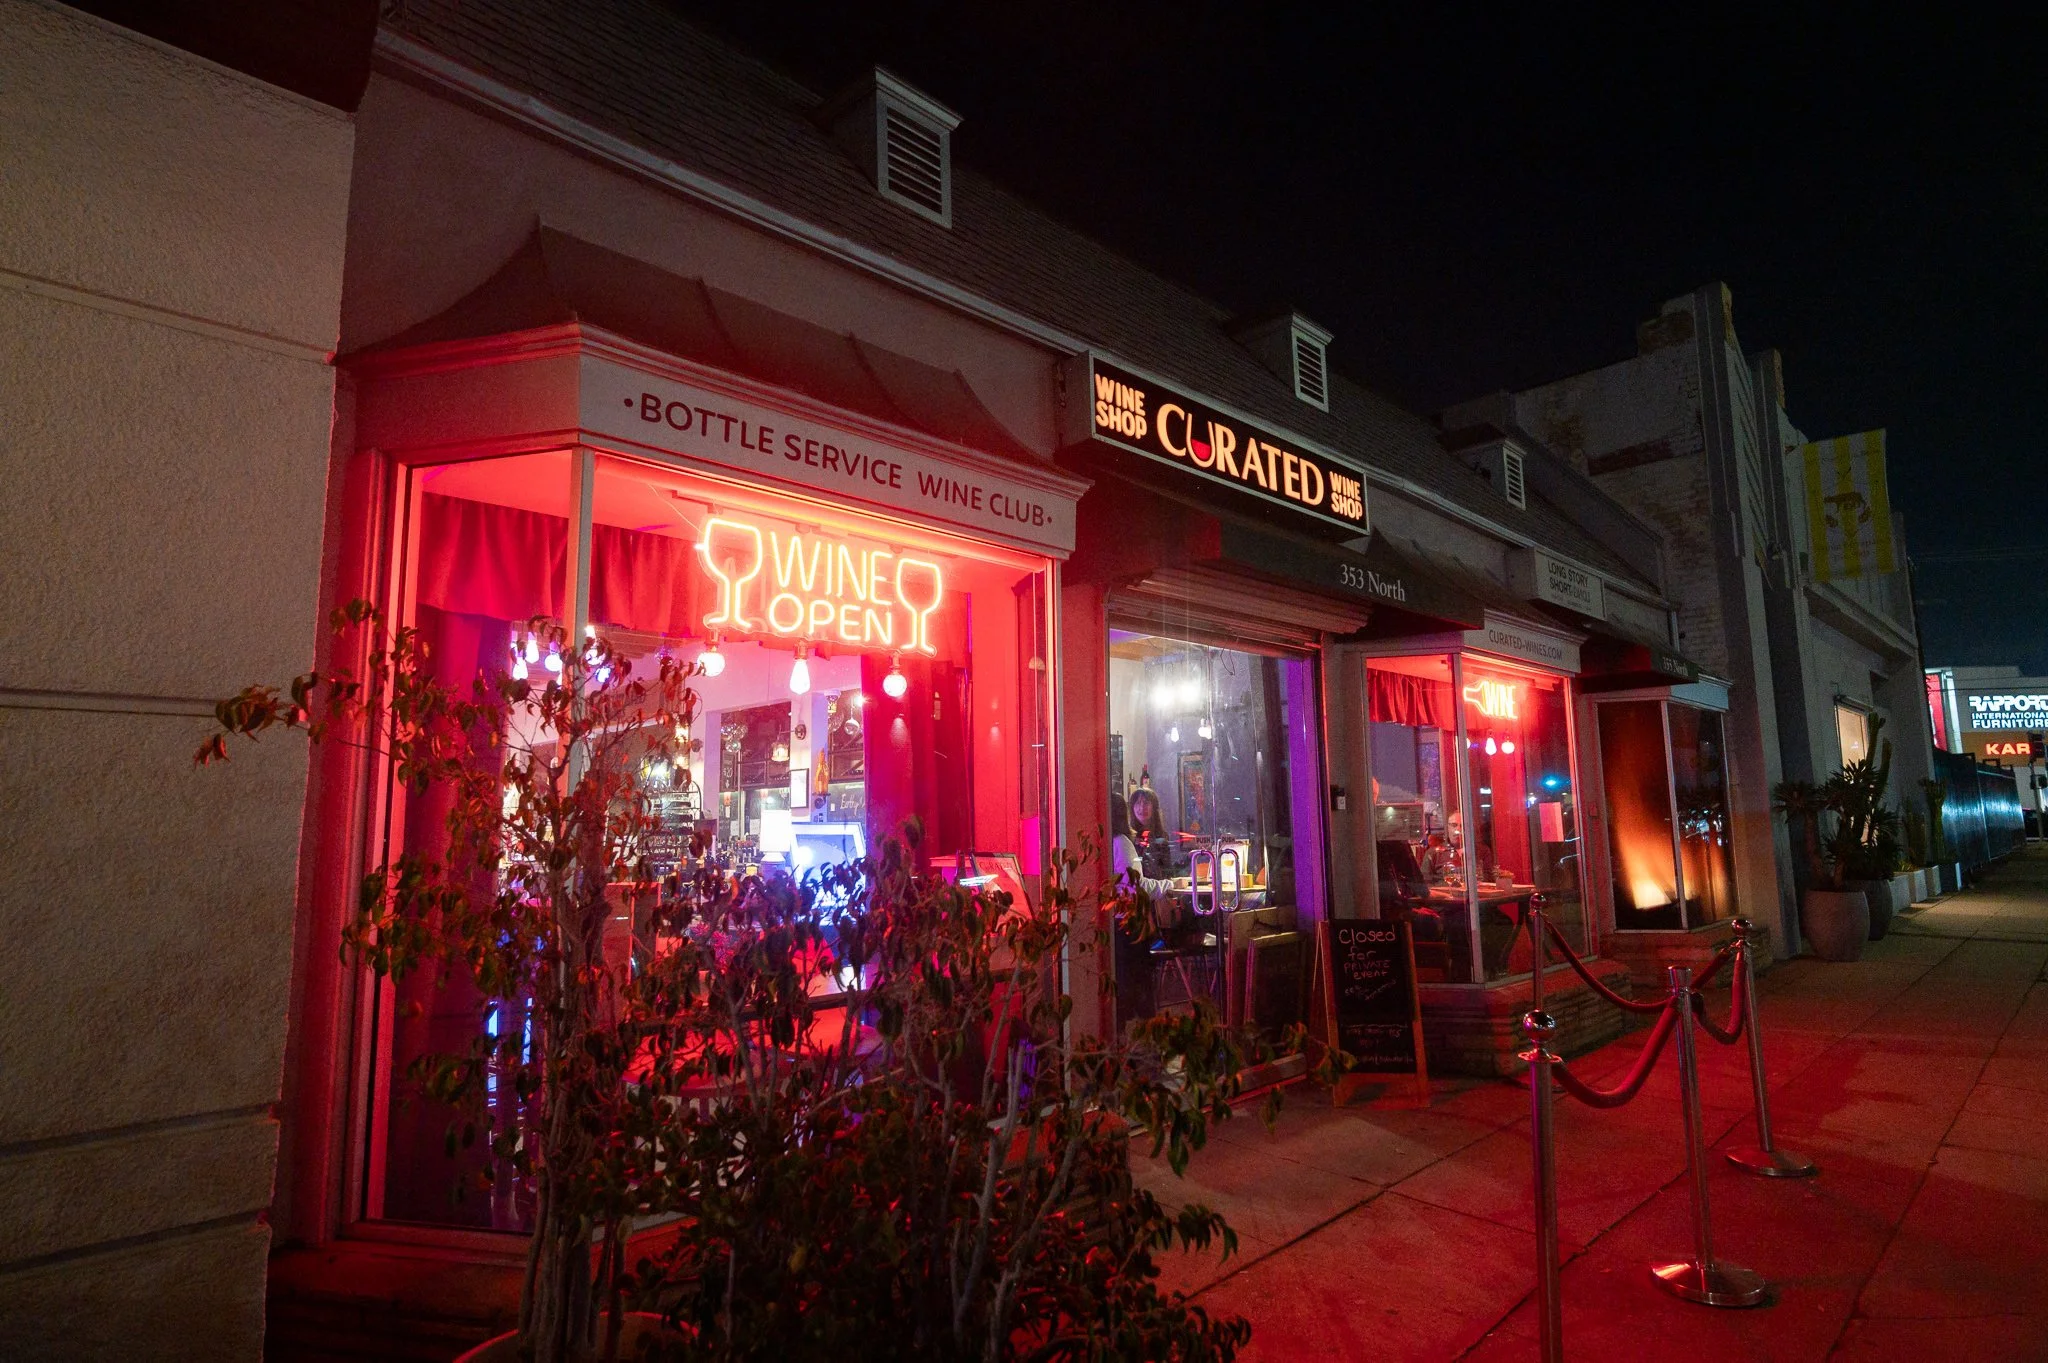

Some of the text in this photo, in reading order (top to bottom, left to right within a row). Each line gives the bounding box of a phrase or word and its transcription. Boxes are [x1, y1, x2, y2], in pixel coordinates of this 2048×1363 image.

[1095, 373, 1146, 416] WINE
[1096, 400, 1147, 440] SHOP
[641, 392, 1044, 527] BOTTLE SERVICE WINE CLUB
[1156, 403, 1324, 506] CURATED
[1329, 470, 1362, 501] WINE
[1331, 492, 1363, 521] SHOP
[769, 531, 893, 606] WINE
[1340, 563, 1406, 602] 353 North
[1547, 560, 1588, 588] LONG STORY
[768, 592, 893, 645] OPEN
[1488, 629, 1563, 660] CURATED-WINES.COM
[1482, 681, 1518, 720] WINE
[1339, 924, 1396, 945] Closed
[1347, 945, 1377, 961] for
[1353, 970, 1388, 980] event
